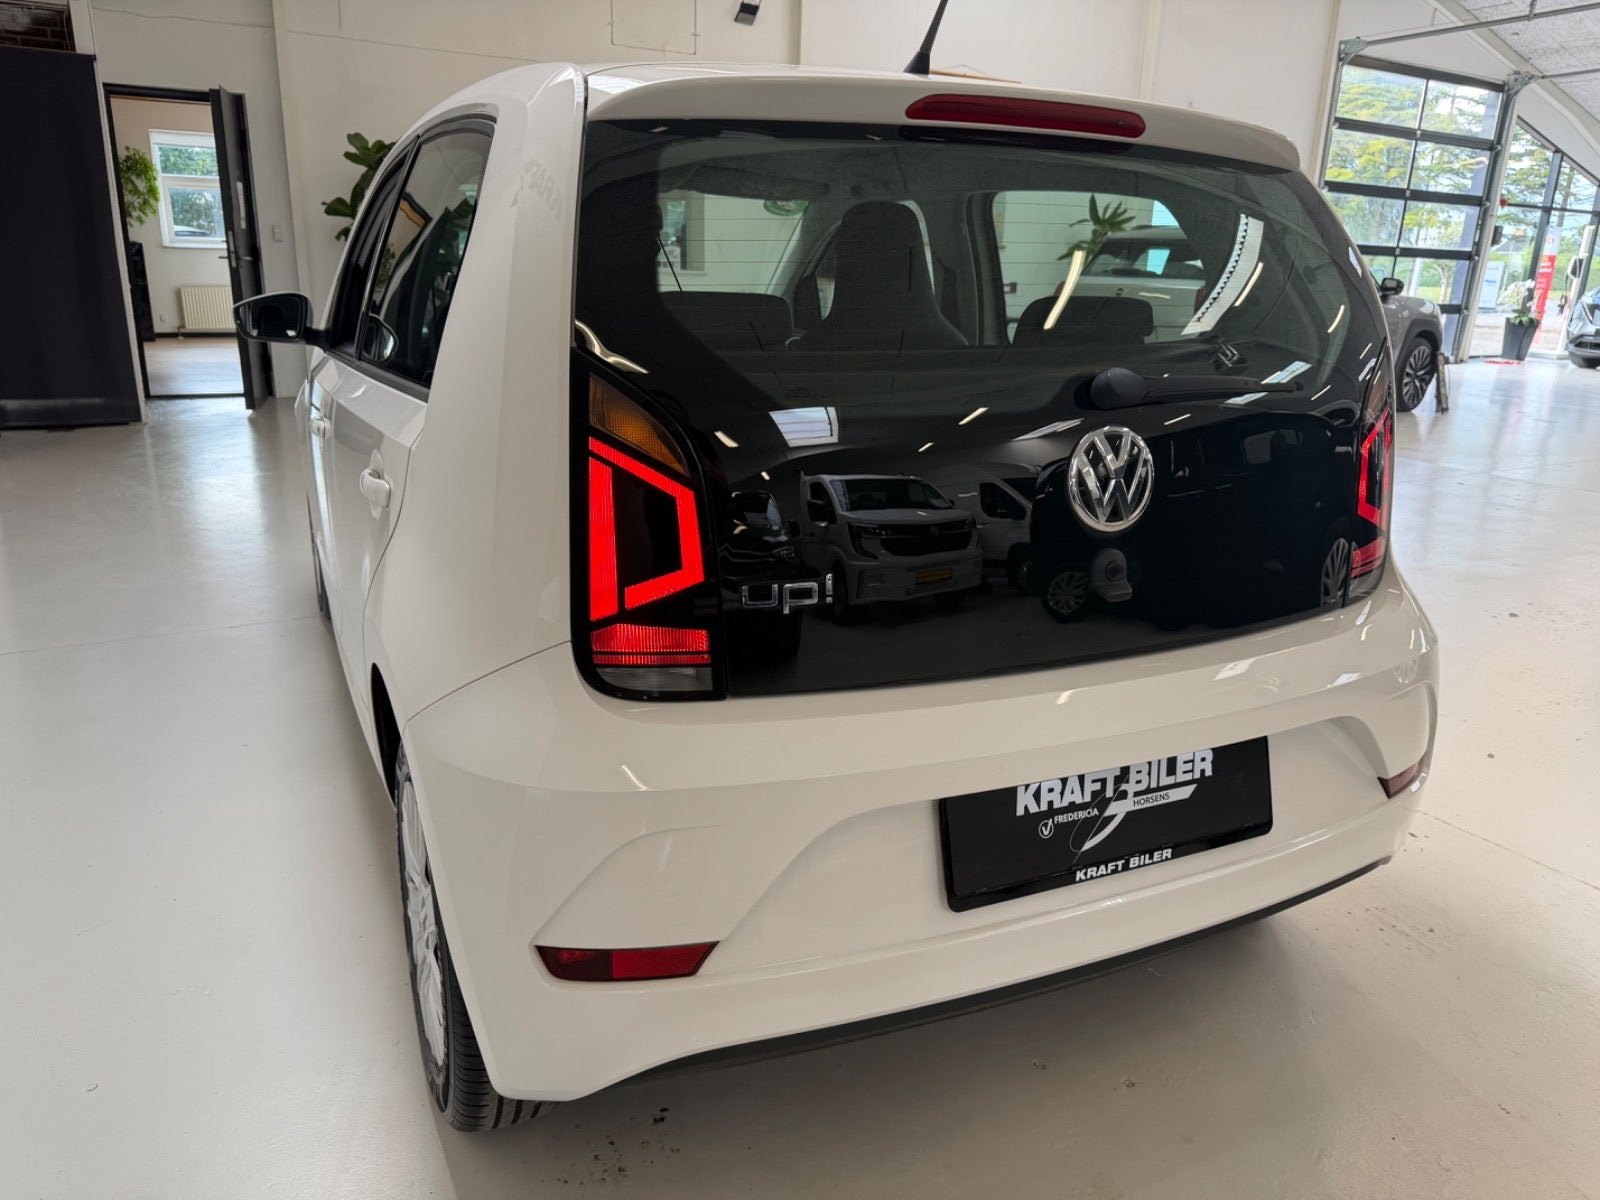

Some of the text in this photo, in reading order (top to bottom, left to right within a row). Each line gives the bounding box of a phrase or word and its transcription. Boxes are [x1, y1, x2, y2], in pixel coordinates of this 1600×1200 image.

[741, 573, 833, 614] up!
[1016, 748, 1214, 816] KRAFT BILER
[1053, 807, 1099, 825] FREDERICIA
[1132, 792, 1170, 808] HORSENS
[1075, 848, 1173, 882] KRAFT BILER
